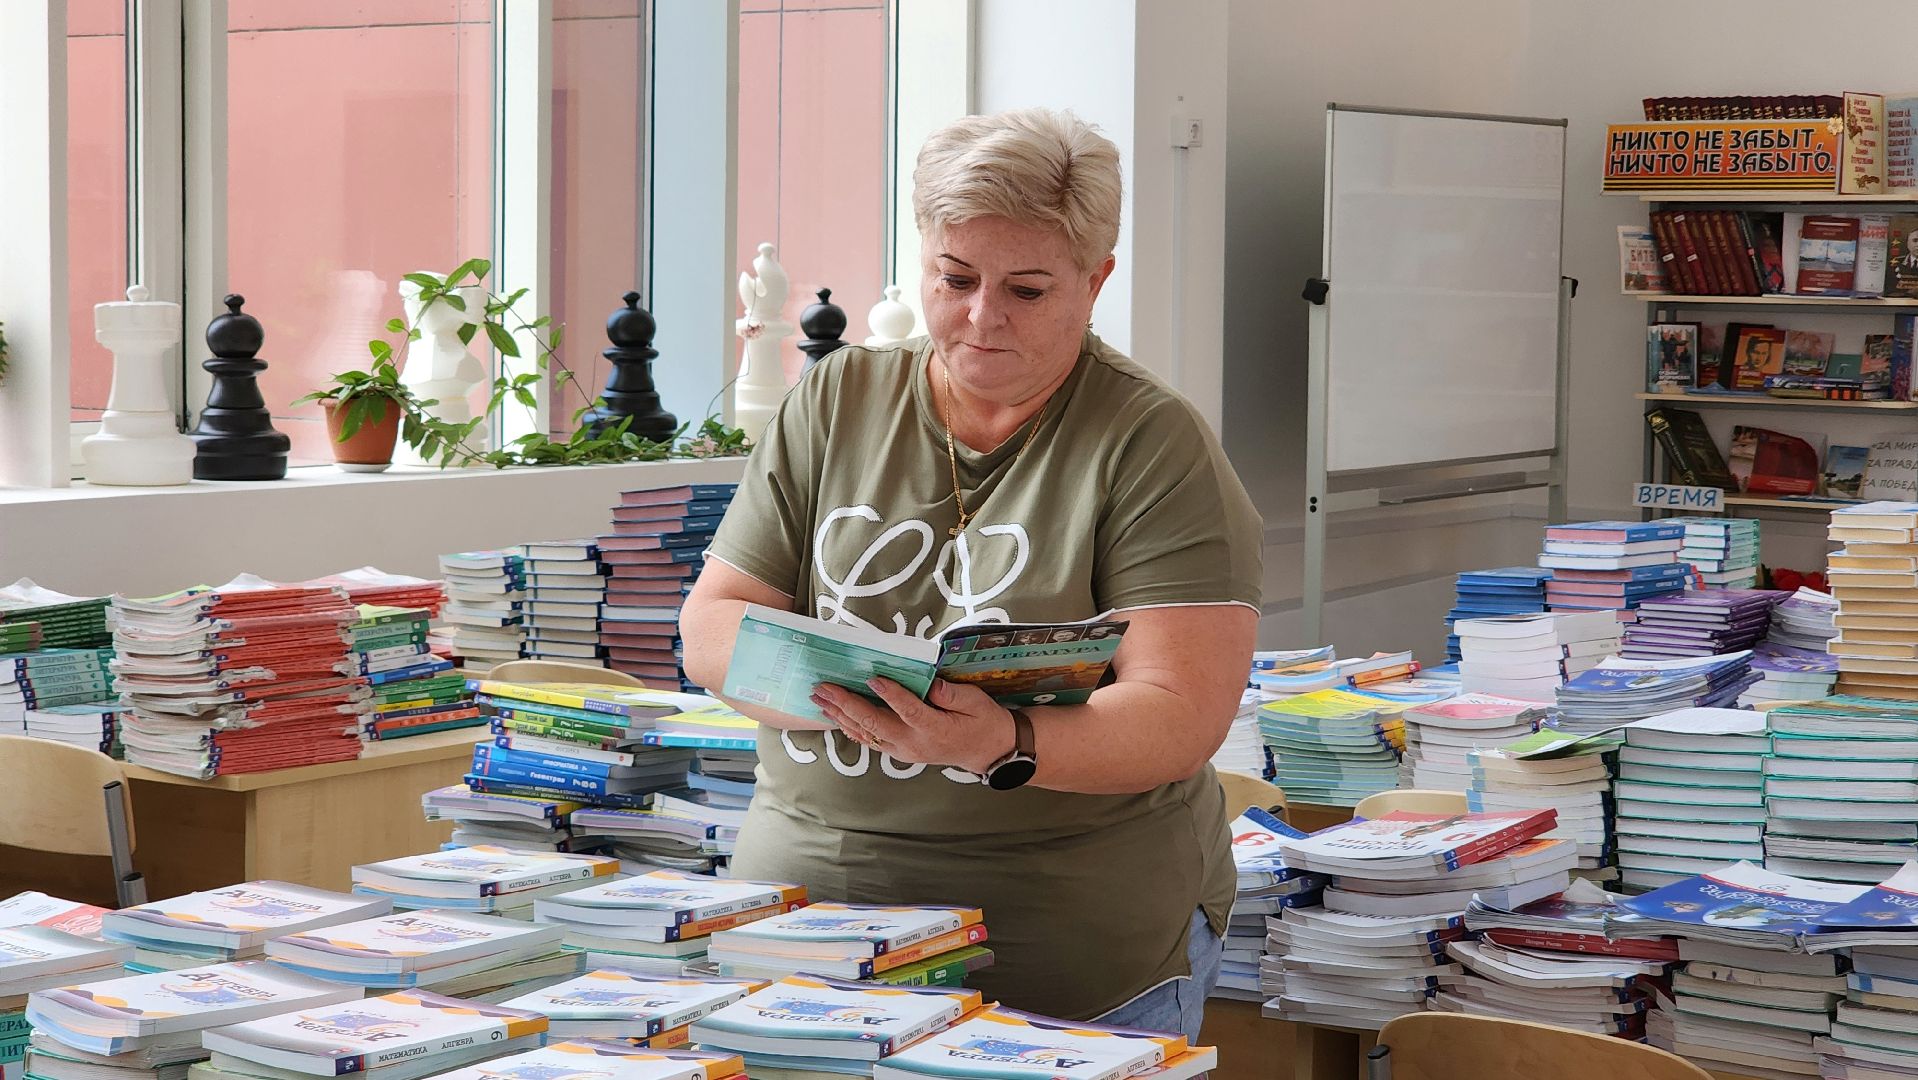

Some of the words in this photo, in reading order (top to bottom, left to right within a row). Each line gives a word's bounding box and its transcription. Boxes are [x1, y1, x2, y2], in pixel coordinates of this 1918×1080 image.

[1611, 130, 1690, 152] НИКТО
[1694, 130, 1724, 152] НЕ
[1728, 128, 1824, 151] ЗАБЫТ,
[1609, 153, 1688, 176] НИЧТО
[1692, 153, 1723, 175] НЕ
[1637, 485, 1718, 507] ВРЕМЯ
[1032, 693, 1057, 704] 9
[378, 1046, 428, 1063] МАТЕМАТИКА
[441, 1036, 475, 1050] АЛГЕБРА
[490, 1030, 503, 1041] 9
